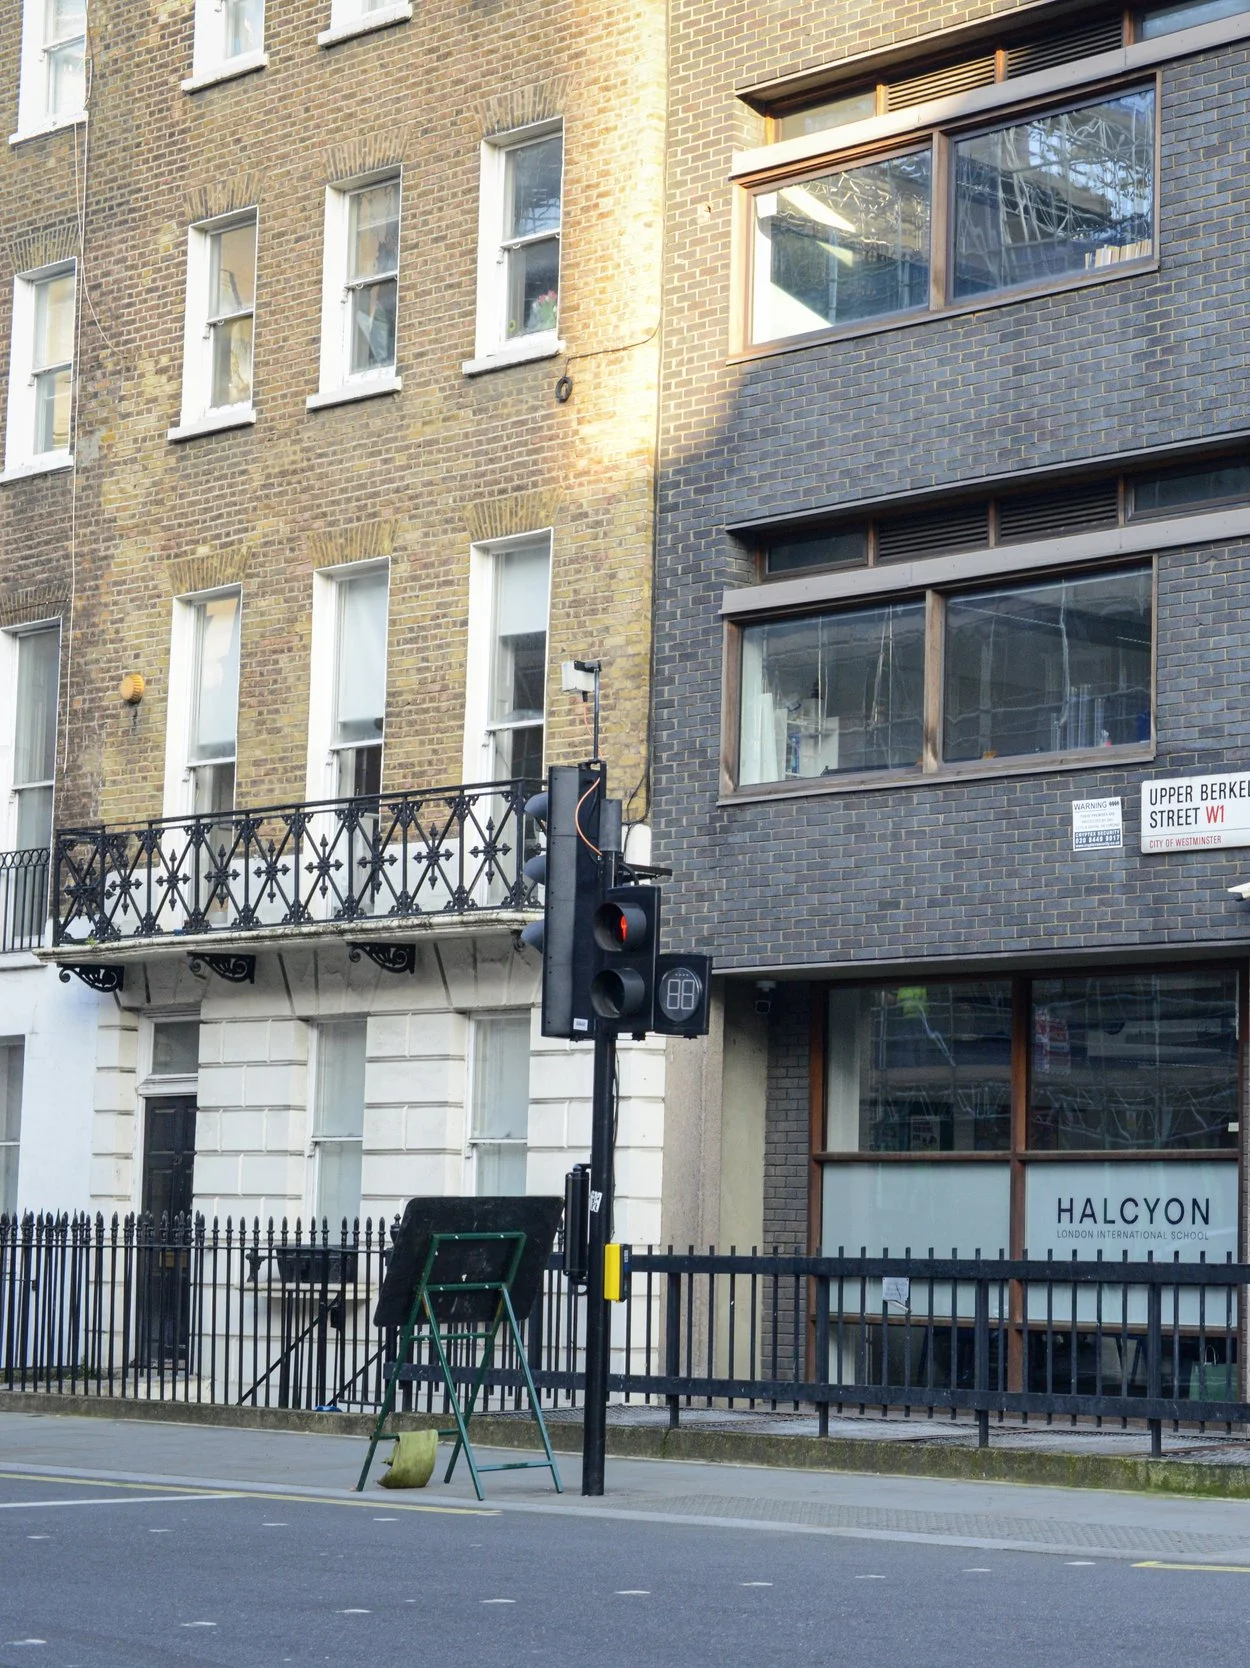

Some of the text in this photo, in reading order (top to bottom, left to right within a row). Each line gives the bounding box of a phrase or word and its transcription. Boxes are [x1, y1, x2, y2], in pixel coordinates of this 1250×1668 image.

[1150, 785, 1193, 805] UPPER
[1074, 801, 1108, 810] WARNING
[1150, 805, 1224, 828] STREET W1
[1149, 835, 1222, 848] CITY OF WESTMINSTER
[1057, 1197, 1210, 1226] HALCYON
[1057, 1229, 1209, 1241] LONDON INTERNATIONAL SCHOOL
